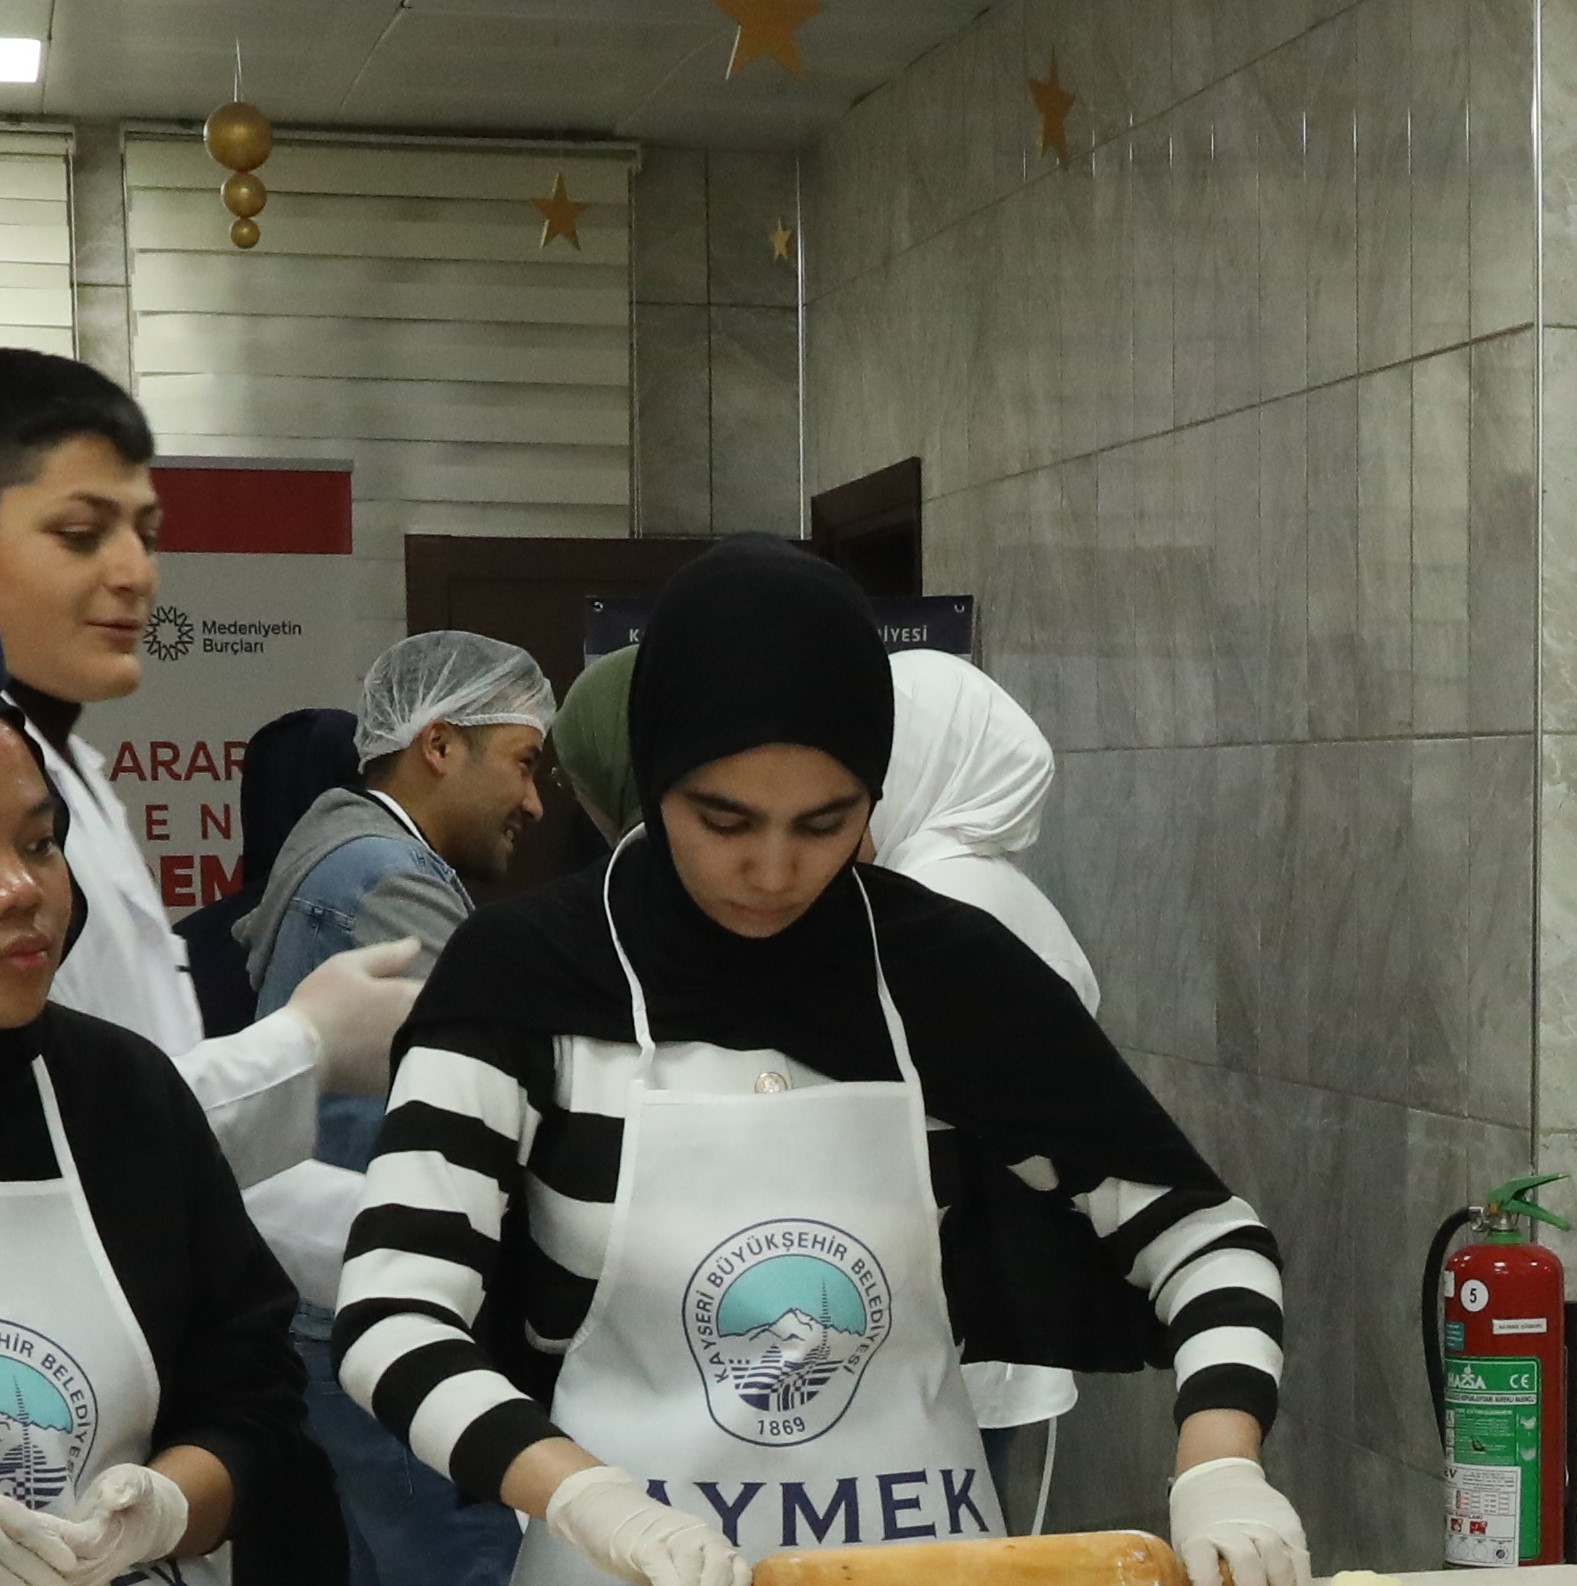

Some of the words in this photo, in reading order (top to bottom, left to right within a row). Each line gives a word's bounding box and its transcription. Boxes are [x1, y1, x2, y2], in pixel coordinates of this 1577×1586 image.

[202, 619, 302, 637] Medeniyetin
[203, 638, 264, 655] Burçları
[877, 624, 928, 642] İYESİ
[147, 854, 244, 908] EM
[707, 1231, 848, 1289] BÜYÜKŞEHİR
[1469, 1287, 1477, 1304] 5
[843, 1257, 887, 1376] BELEDİYESİ
[695, 1289, 729, 1384] KAYSERİ
[757, 1416, 806, 1437] 1869
[645, 1468, 991, 1548] YMEK
